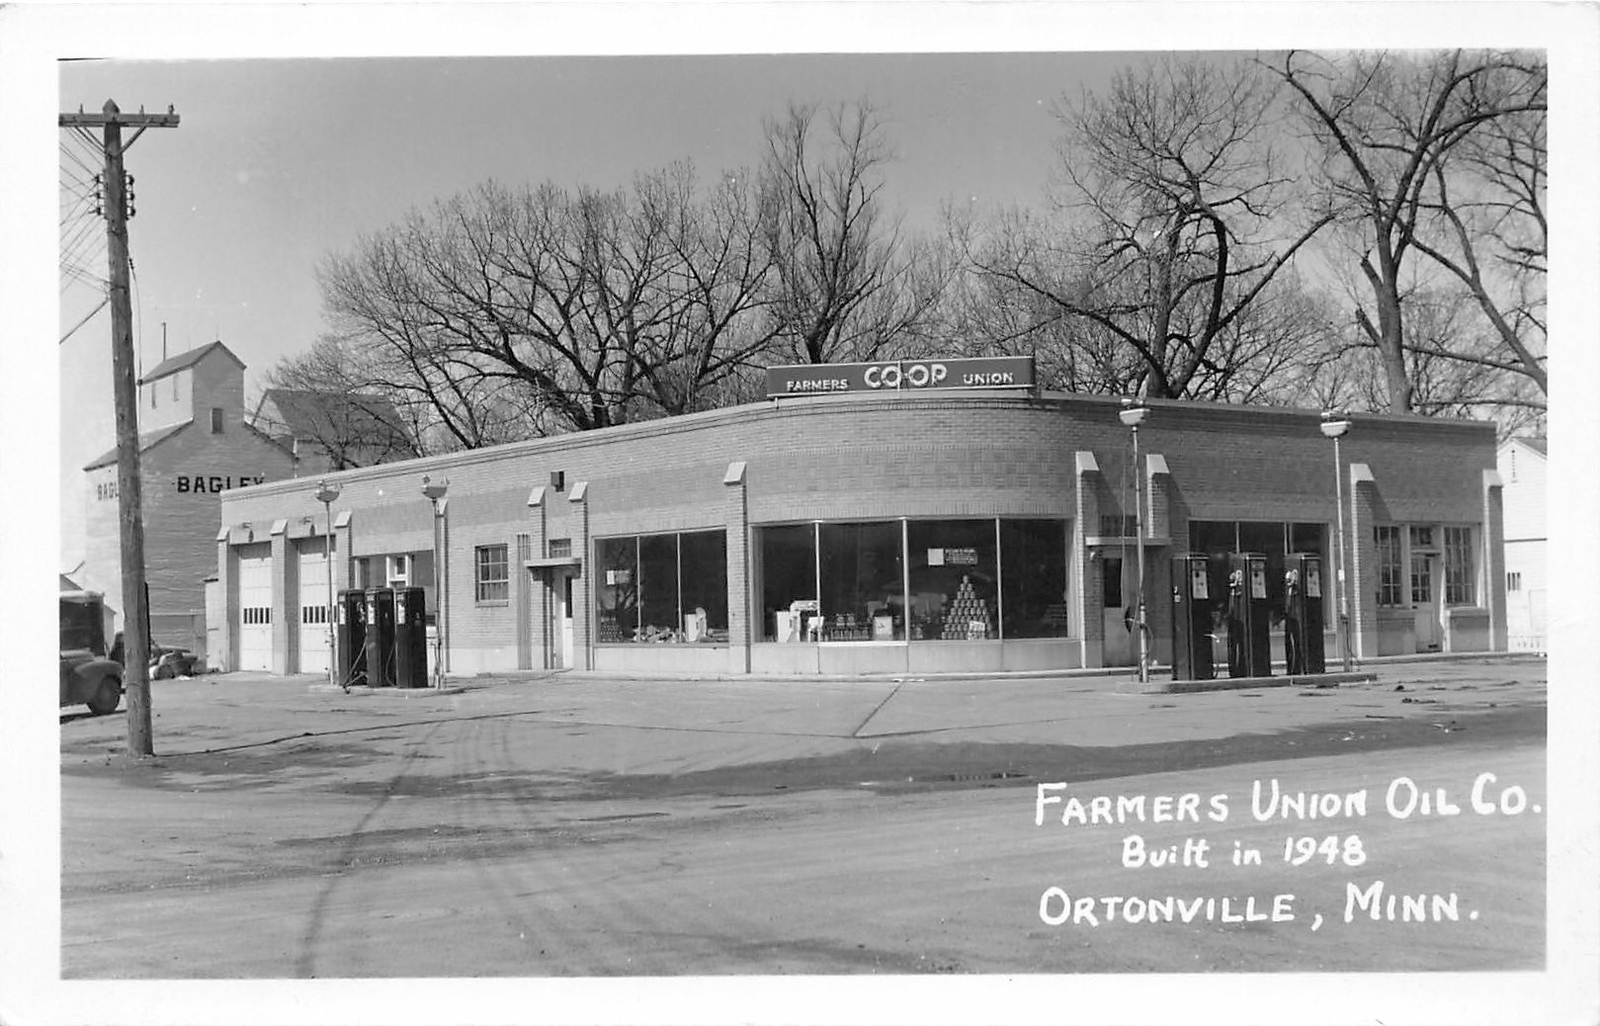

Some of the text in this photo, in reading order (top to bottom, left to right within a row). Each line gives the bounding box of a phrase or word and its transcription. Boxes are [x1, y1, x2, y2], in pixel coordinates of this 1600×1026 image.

[786, 378, 848, 391] FARMERS
[962, 372, 1014, 385] UNION
[97, 482, 119, 500] BAGL
[177, 476, 264, 493] BAGLEY
